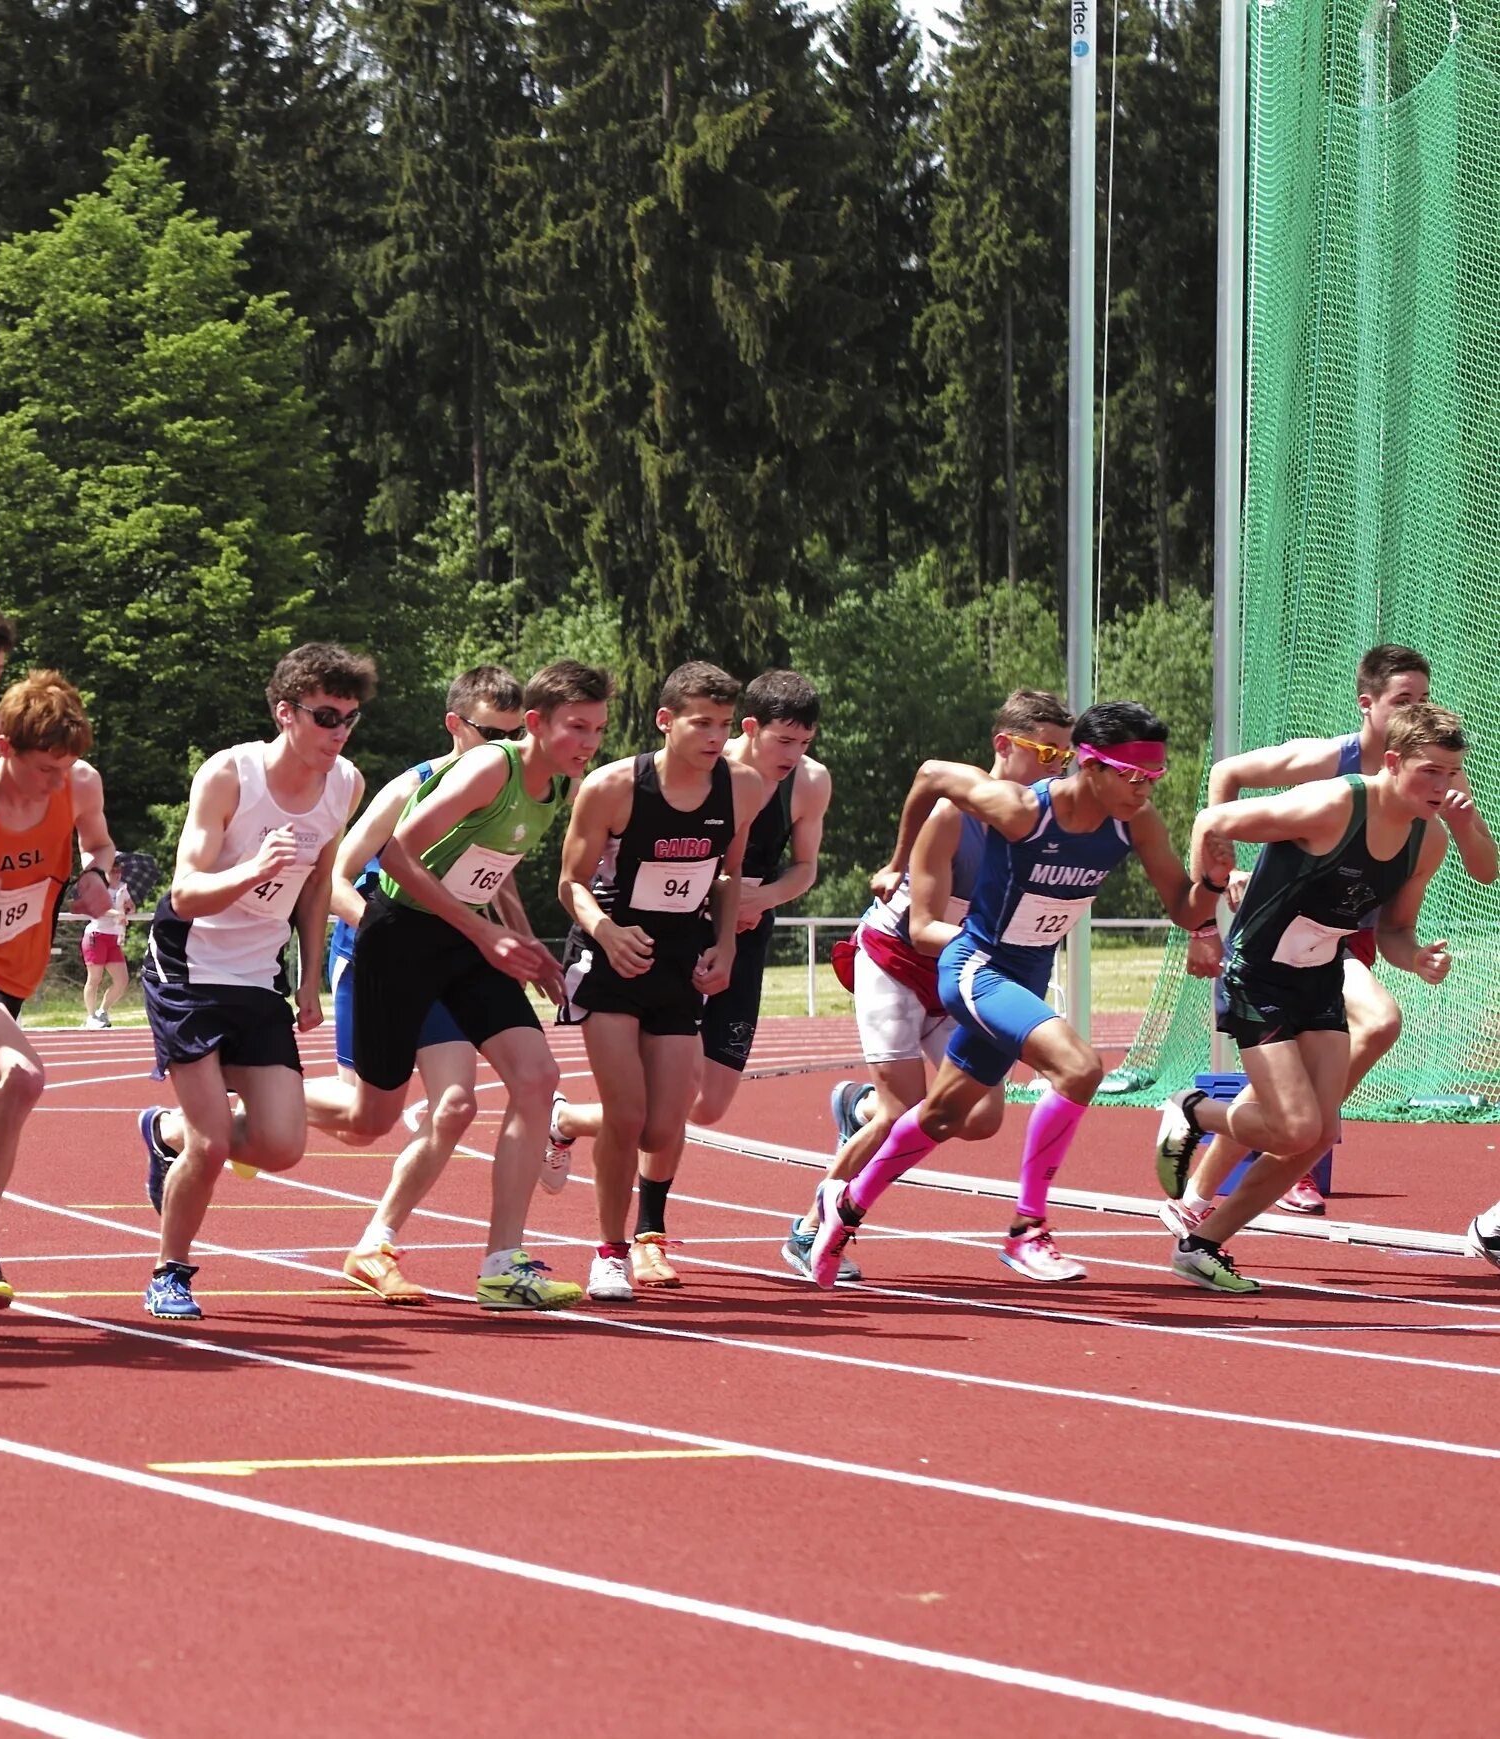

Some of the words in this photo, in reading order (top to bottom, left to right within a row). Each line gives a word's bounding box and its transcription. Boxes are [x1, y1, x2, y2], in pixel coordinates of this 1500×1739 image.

[654, 838, 712, 858] CAIRO
[0, 849, 44, 871] ASL
[469, 867, 503, 890] 169
[1028, 863, 1110, 887] MUNICH
[253, 881, 284, 902] 47
[663, 879, 691, 898] 94
[1034, 914, 1069, 933] 122
